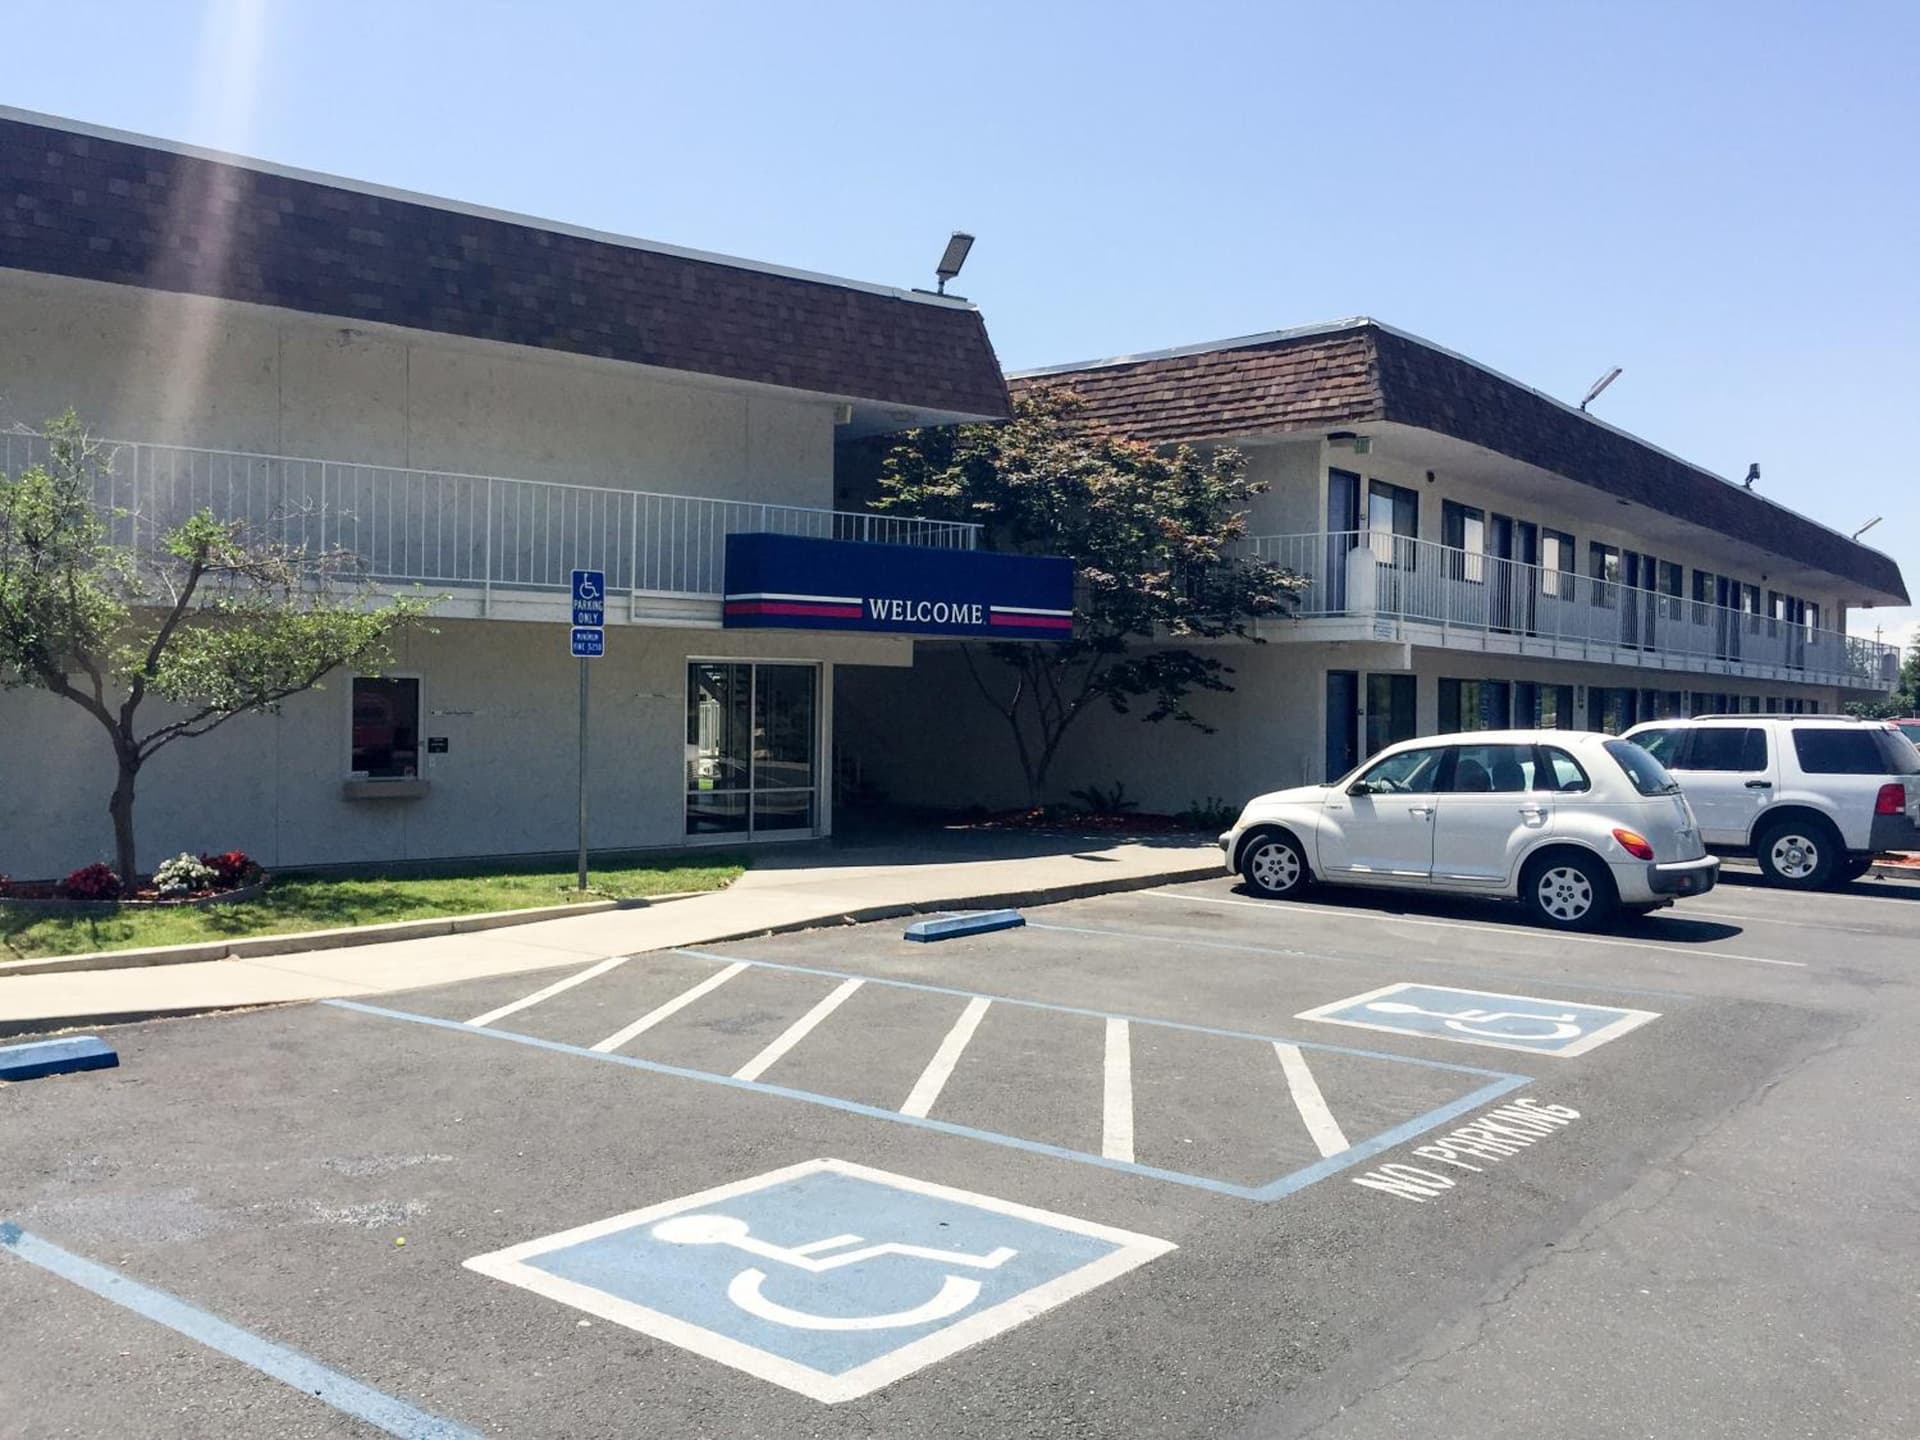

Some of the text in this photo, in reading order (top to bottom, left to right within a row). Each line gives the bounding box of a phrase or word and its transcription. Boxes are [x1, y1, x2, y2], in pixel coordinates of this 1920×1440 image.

[574, 600, 603, 611] PARKING
[869, 598, 984, 625] WELCOME
[578, 612, 599, 624] ONLY
[1352, 1099, 1581, 1202] NO PARKING
